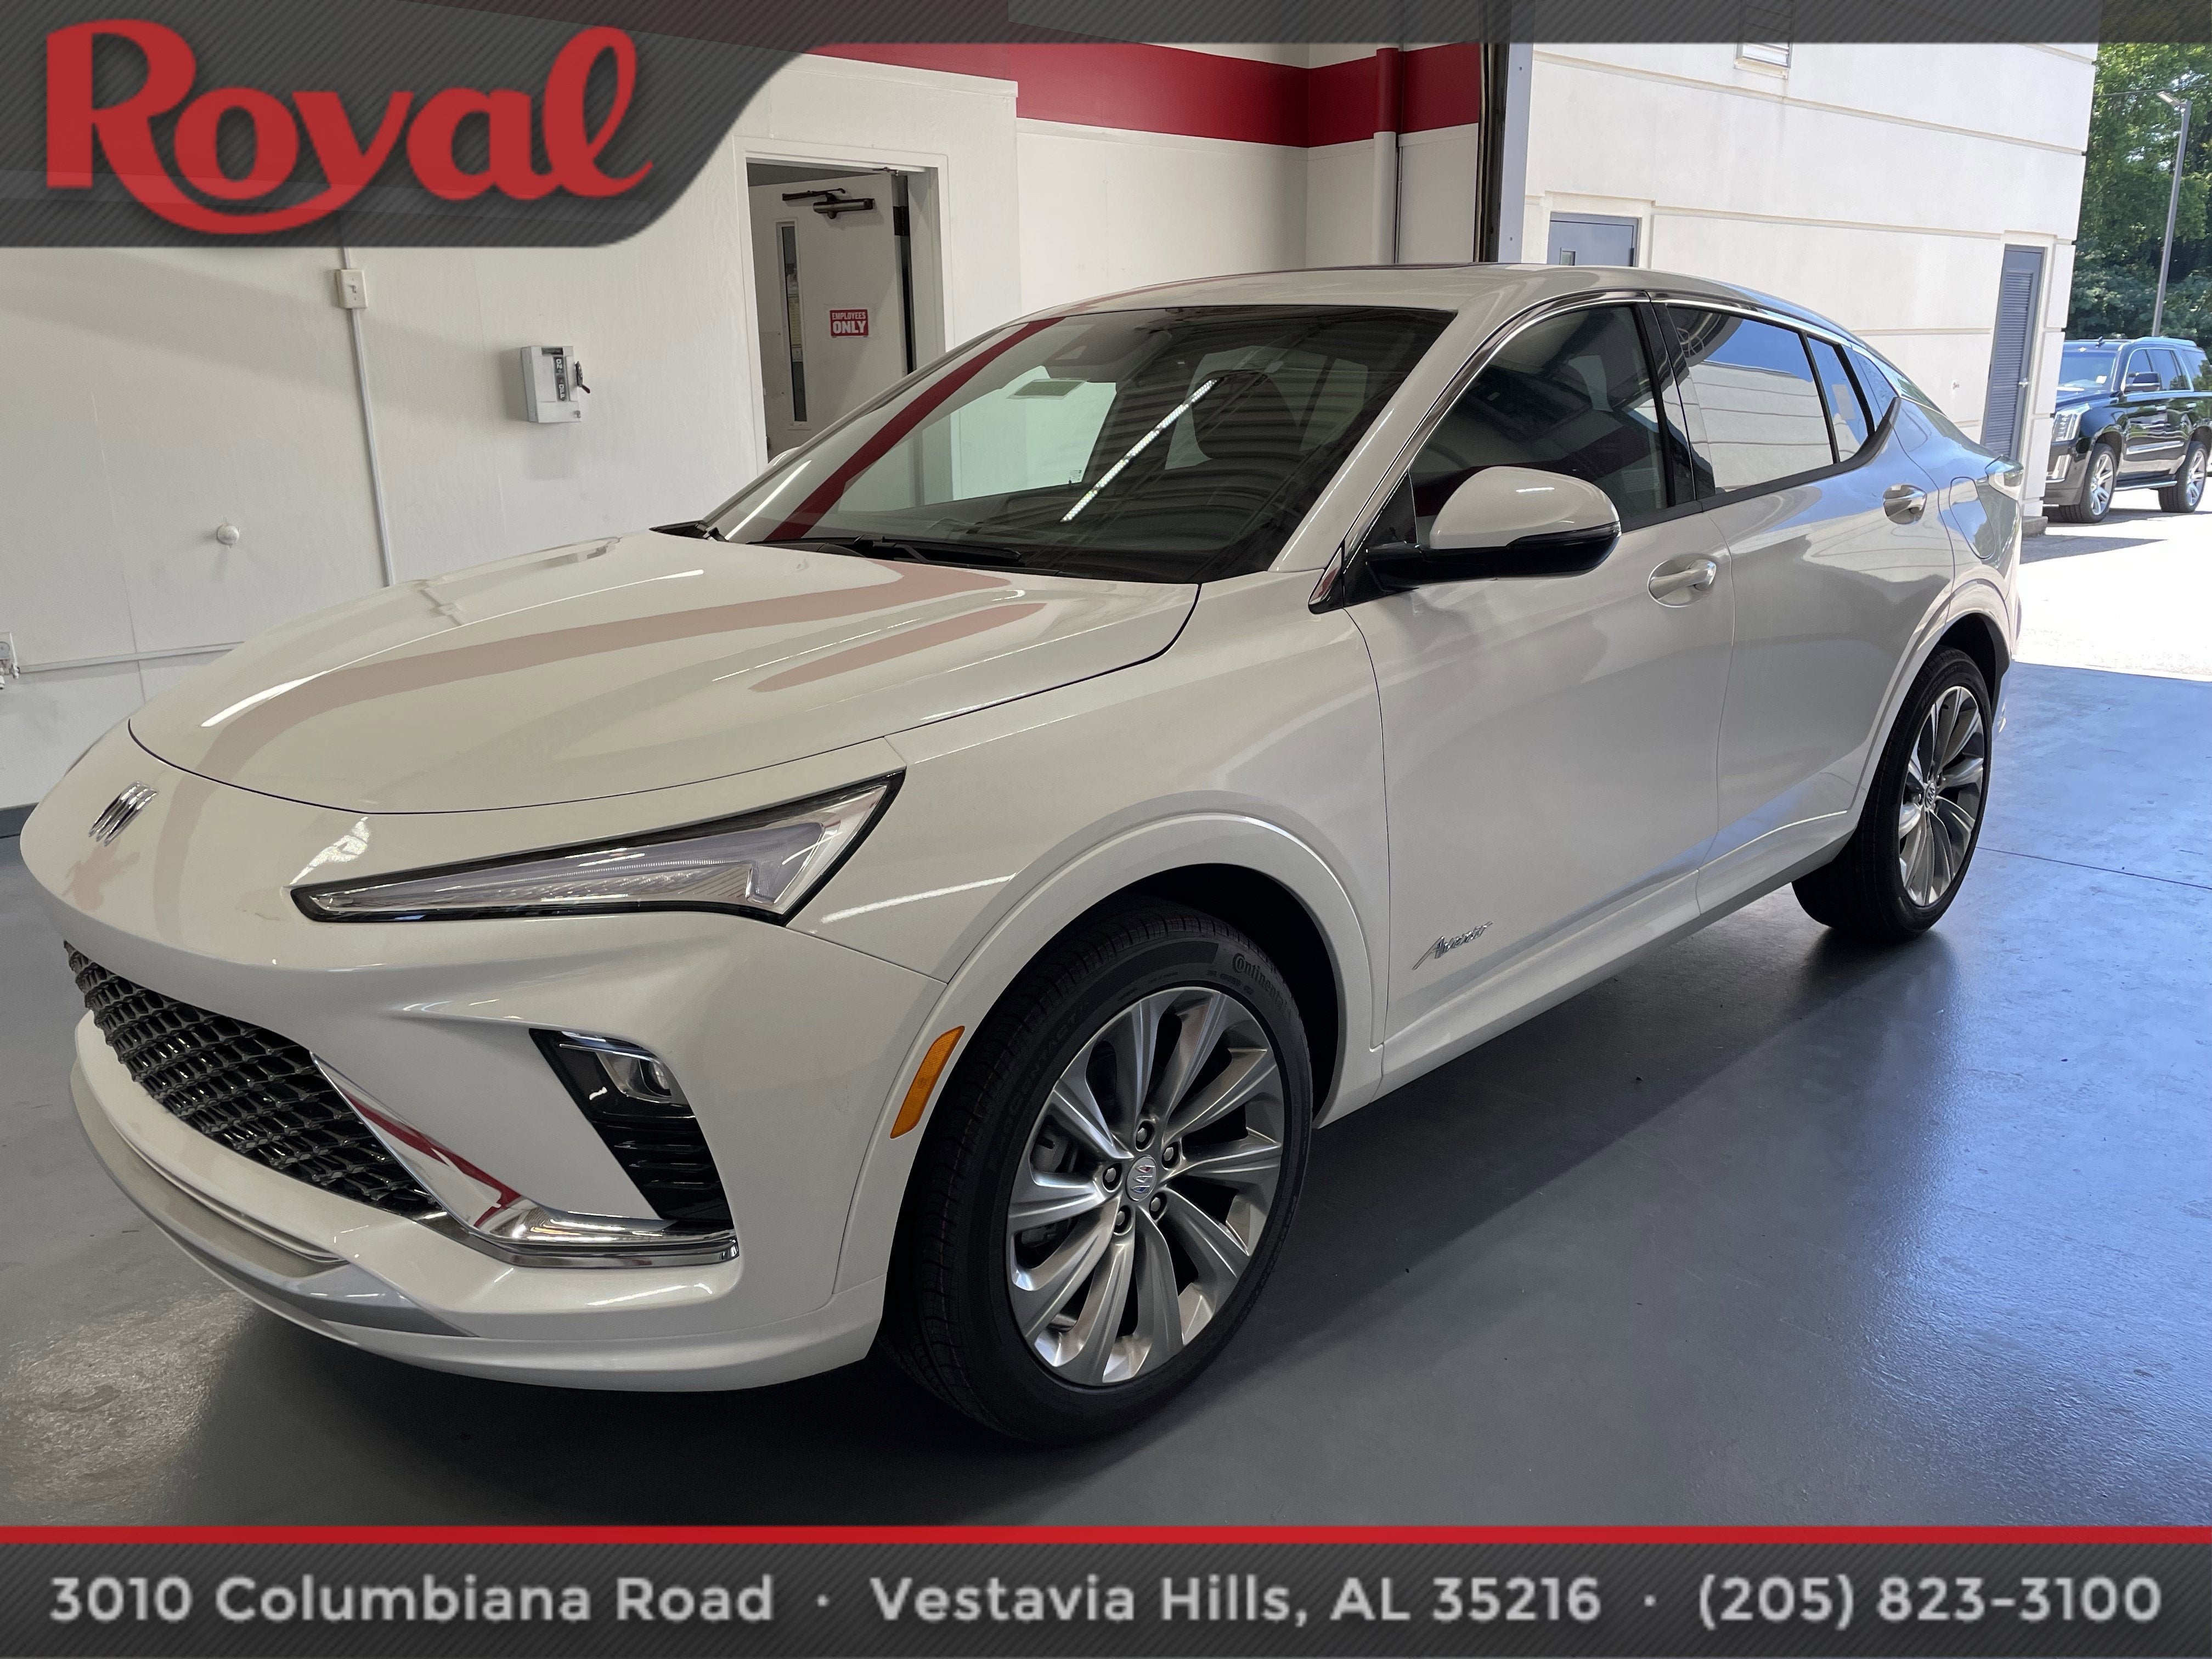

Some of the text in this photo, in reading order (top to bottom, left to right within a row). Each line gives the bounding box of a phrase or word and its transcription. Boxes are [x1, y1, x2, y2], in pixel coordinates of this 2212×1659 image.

[832, 312, 866, 320] EMPLOYEES
[833, 320, 866, 334] ONLY
[556, 358, 562, 369] ON
[1232, 952, 1288, 1013] Continental
